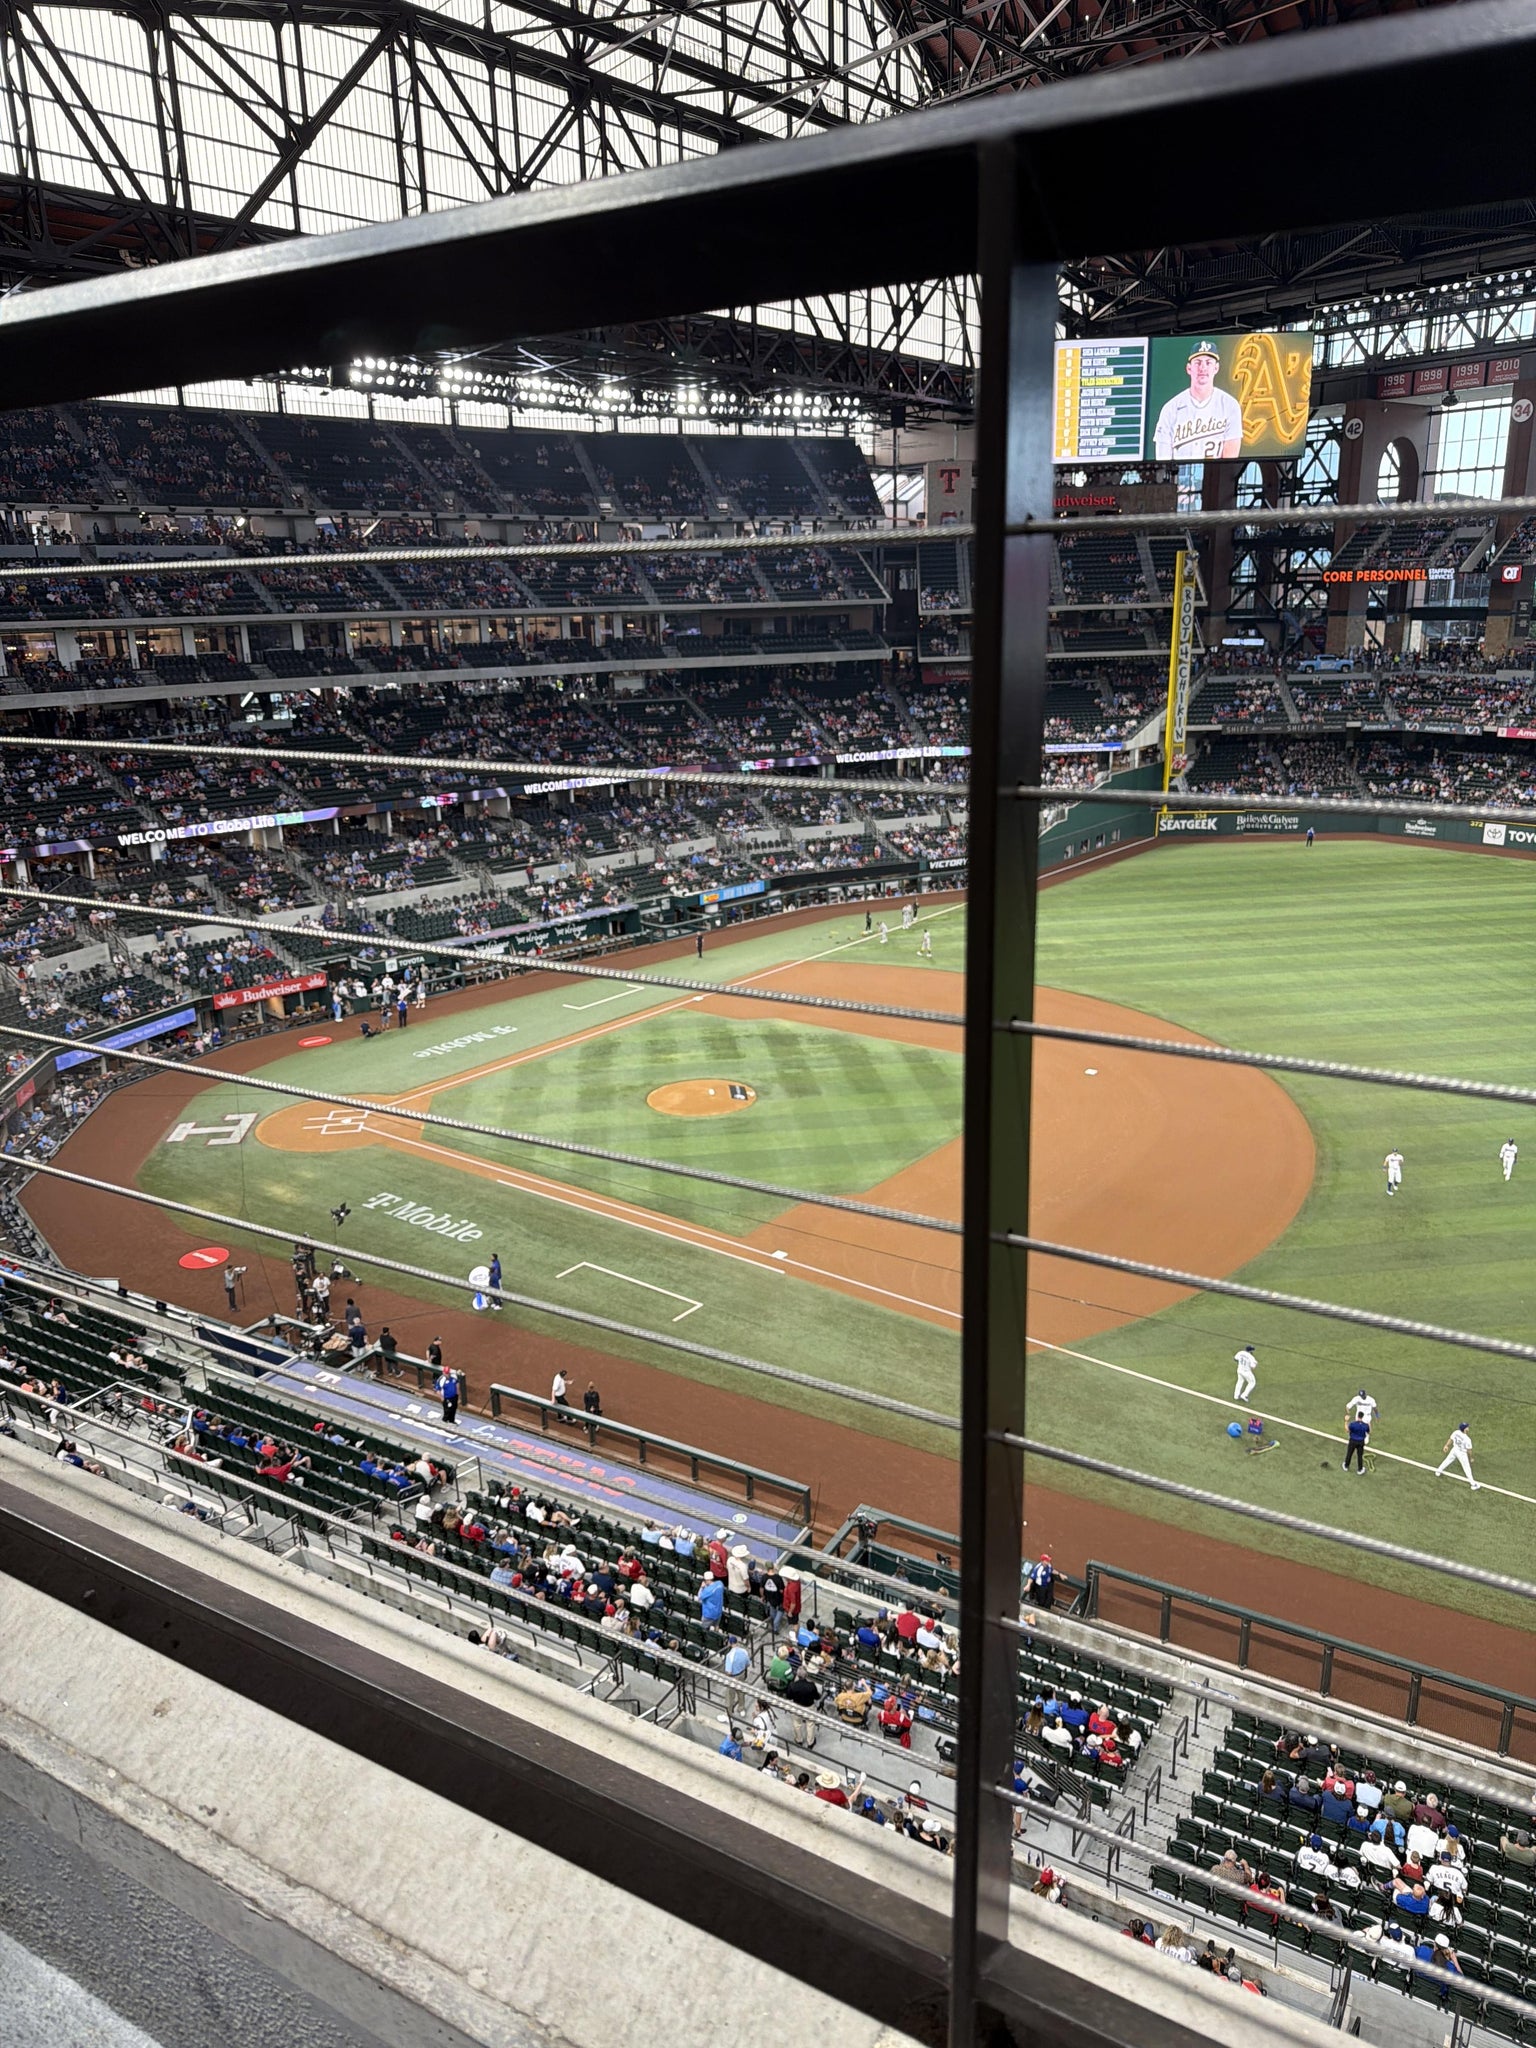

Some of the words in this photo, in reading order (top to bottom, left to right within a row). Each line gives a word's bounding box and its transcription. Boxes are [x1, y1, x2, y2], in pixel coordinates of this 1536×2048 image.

[1456, 364, 1479, 377] 1999
[1496, 359, 1520, 371] 2010
[1384, 374, 1405, 387] 1996
[1420, 369, 1442, 381] 1998
[1514, 404, 1531, 417] 34
[1173, 418, 1228, 443] Athletics
[1347, 423, 1361, 434] 42
[1204, 441, 1222, 458] 21
[939, 468, 960, 494] T
[1052, 495, 1114, 507] udweiser
[1323, 571, 1353, 582] CORE
[1356, 569, 1428, 582] PERSONNEL
[1503, 567, 1520, 580] QT
[1180, 588, 1192, 640] ROOT
[1175, 665, 1188, 742] CHIKIN
[1226, 726, 1249, 734] SHIFT
[1286, 724, 1310, 732] SHIFT
[836, 751, 879, 763] WELCOME
[882, 750, 893, 760] TO
[896, 748, 921, 758] Globe
[523, 780, 569, 794] WELCOME
[571, 779, 583, 788] TO
[118, 826, 185, 846] WELCOME
[191, 824, 208, 836] TO
[213, 818, 250, 834] Globe
[251, 815, 275, 829] Life
[1159, 818, 1218, 831] SEATGEEK
[929, 857, 969, 870] VICTORY
[399, 956, 425, 967] TOYOTA
[242, 982, 302, 1002] Budweiser
[166, 1112, 259, 1146] T
[1435, 1873, 1459, 1883] SEAGER
